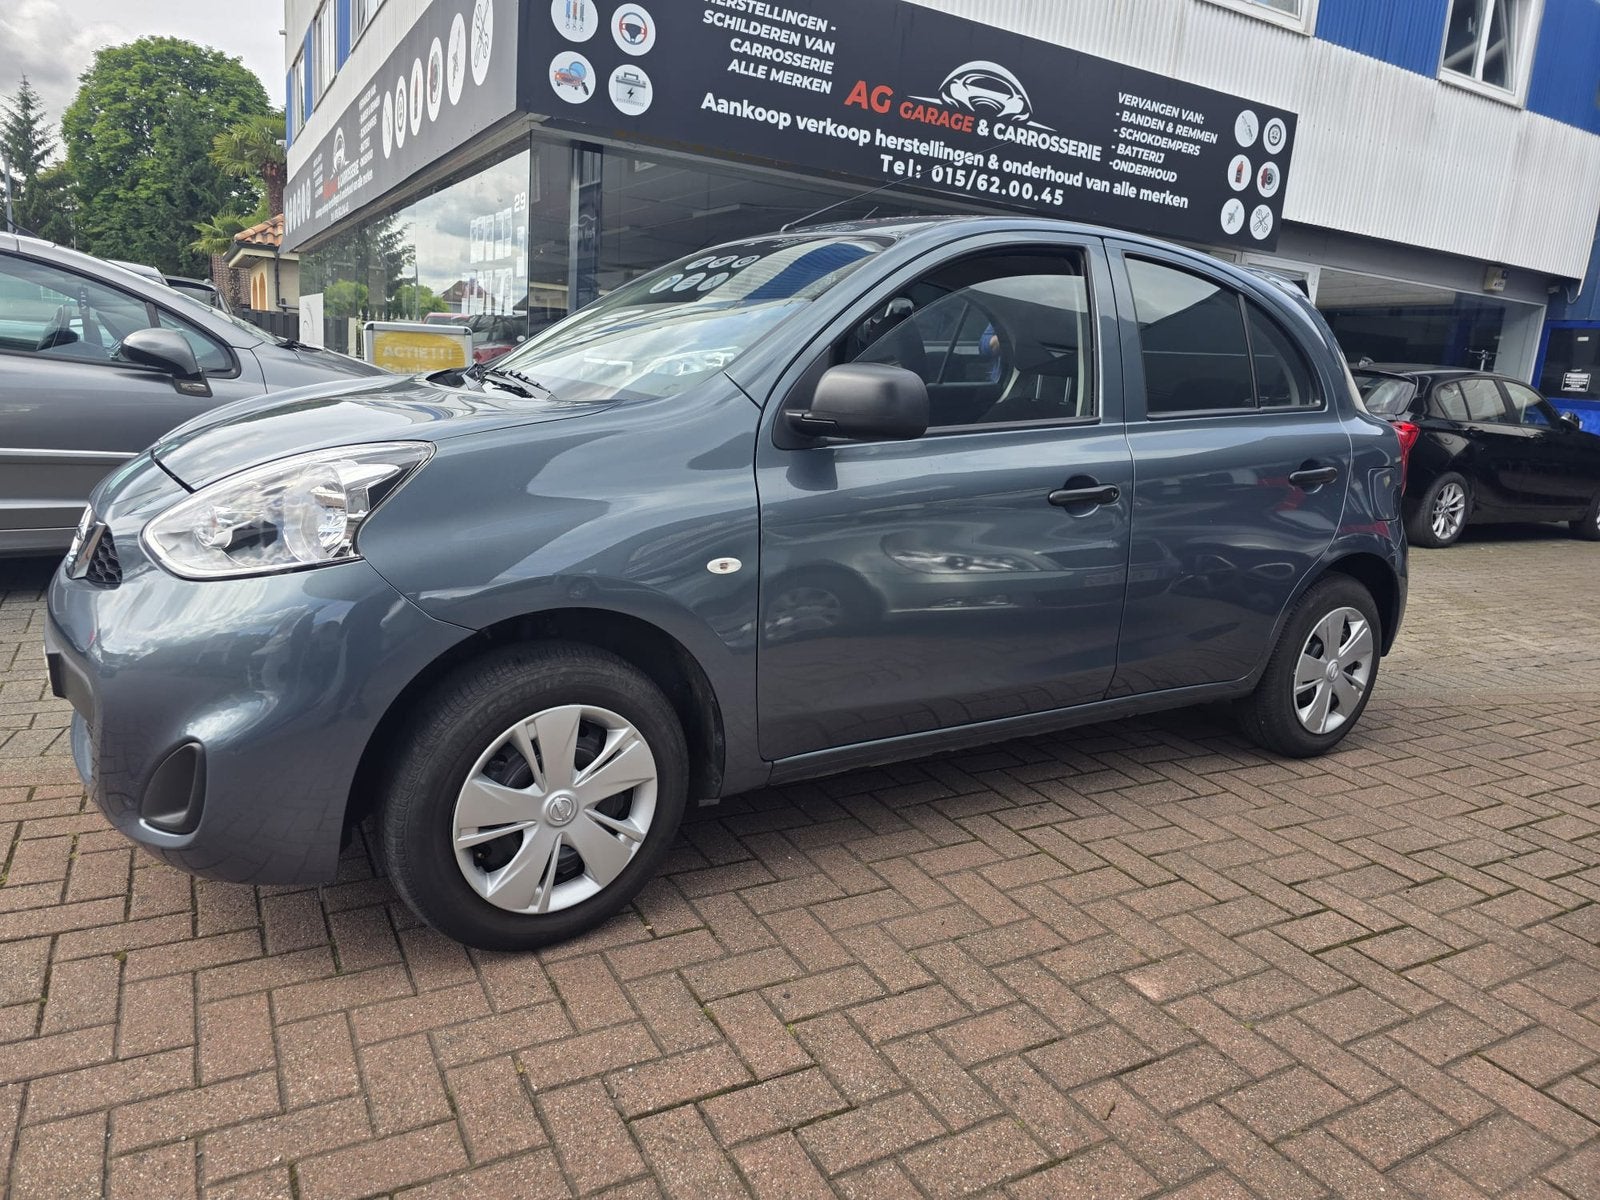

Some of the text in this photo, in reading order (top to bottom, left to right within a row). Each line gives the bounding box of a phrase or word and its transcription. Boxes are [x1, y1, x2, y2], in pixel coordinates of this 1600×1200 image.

[703, 10, 836, 55] SCHILDEREN VAN
[704, 0, 828, 32] ERSTELLINGEN
[730, 38, 835, 74] CARROSSERIE
[727, 59, 833, 94] ALLE MERKEN
[844, 80, 1103, 162] AG GARAGE & CARROSSERIE
[1118, 92, 1205, 125] VERVANGEN VAN:
[1119, 127, 1201, 156] SCHOKDEMPERS
[1121, 110, 1166, 131] BANDEN
[1166, 122, 1174, 133] &
[1175, 124, 1218, 144] REMMEN
[701, 92, 1189, 209] Aankoop verkoop herstellingen & onderhoud van alle merken
[1117, 143, 1165, 164] BATTERIJ
[880, 154, 1064, 206] Tel: 015/62.00.45
[514, 192, 526, 213] 29
